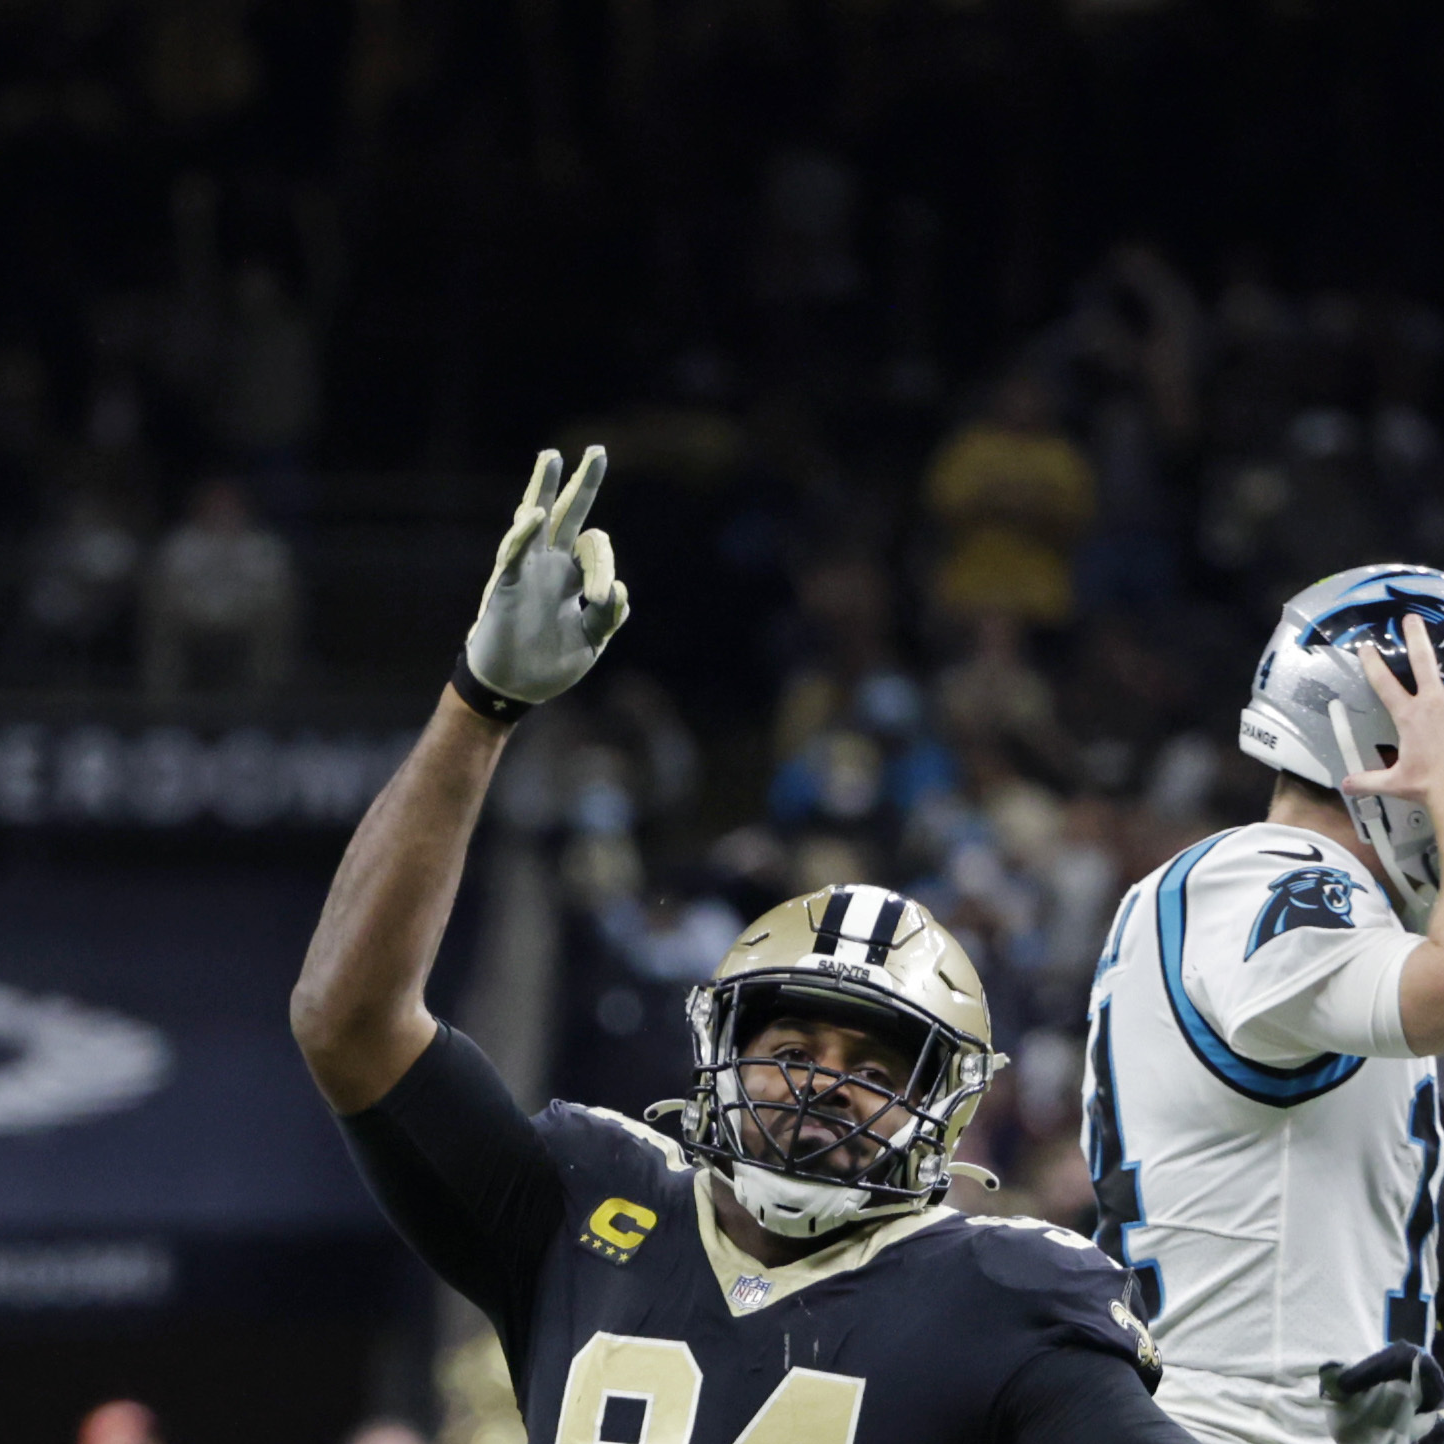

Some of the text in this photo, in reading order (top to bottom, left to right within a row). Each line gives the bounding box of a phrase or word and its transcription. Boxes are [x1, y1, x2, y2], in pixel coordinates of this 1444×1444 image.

[817, 959, 871, 981] SAINTS
[588, 1197, 658, 1250] C
[735, 1284, 762, 1305] NFL
